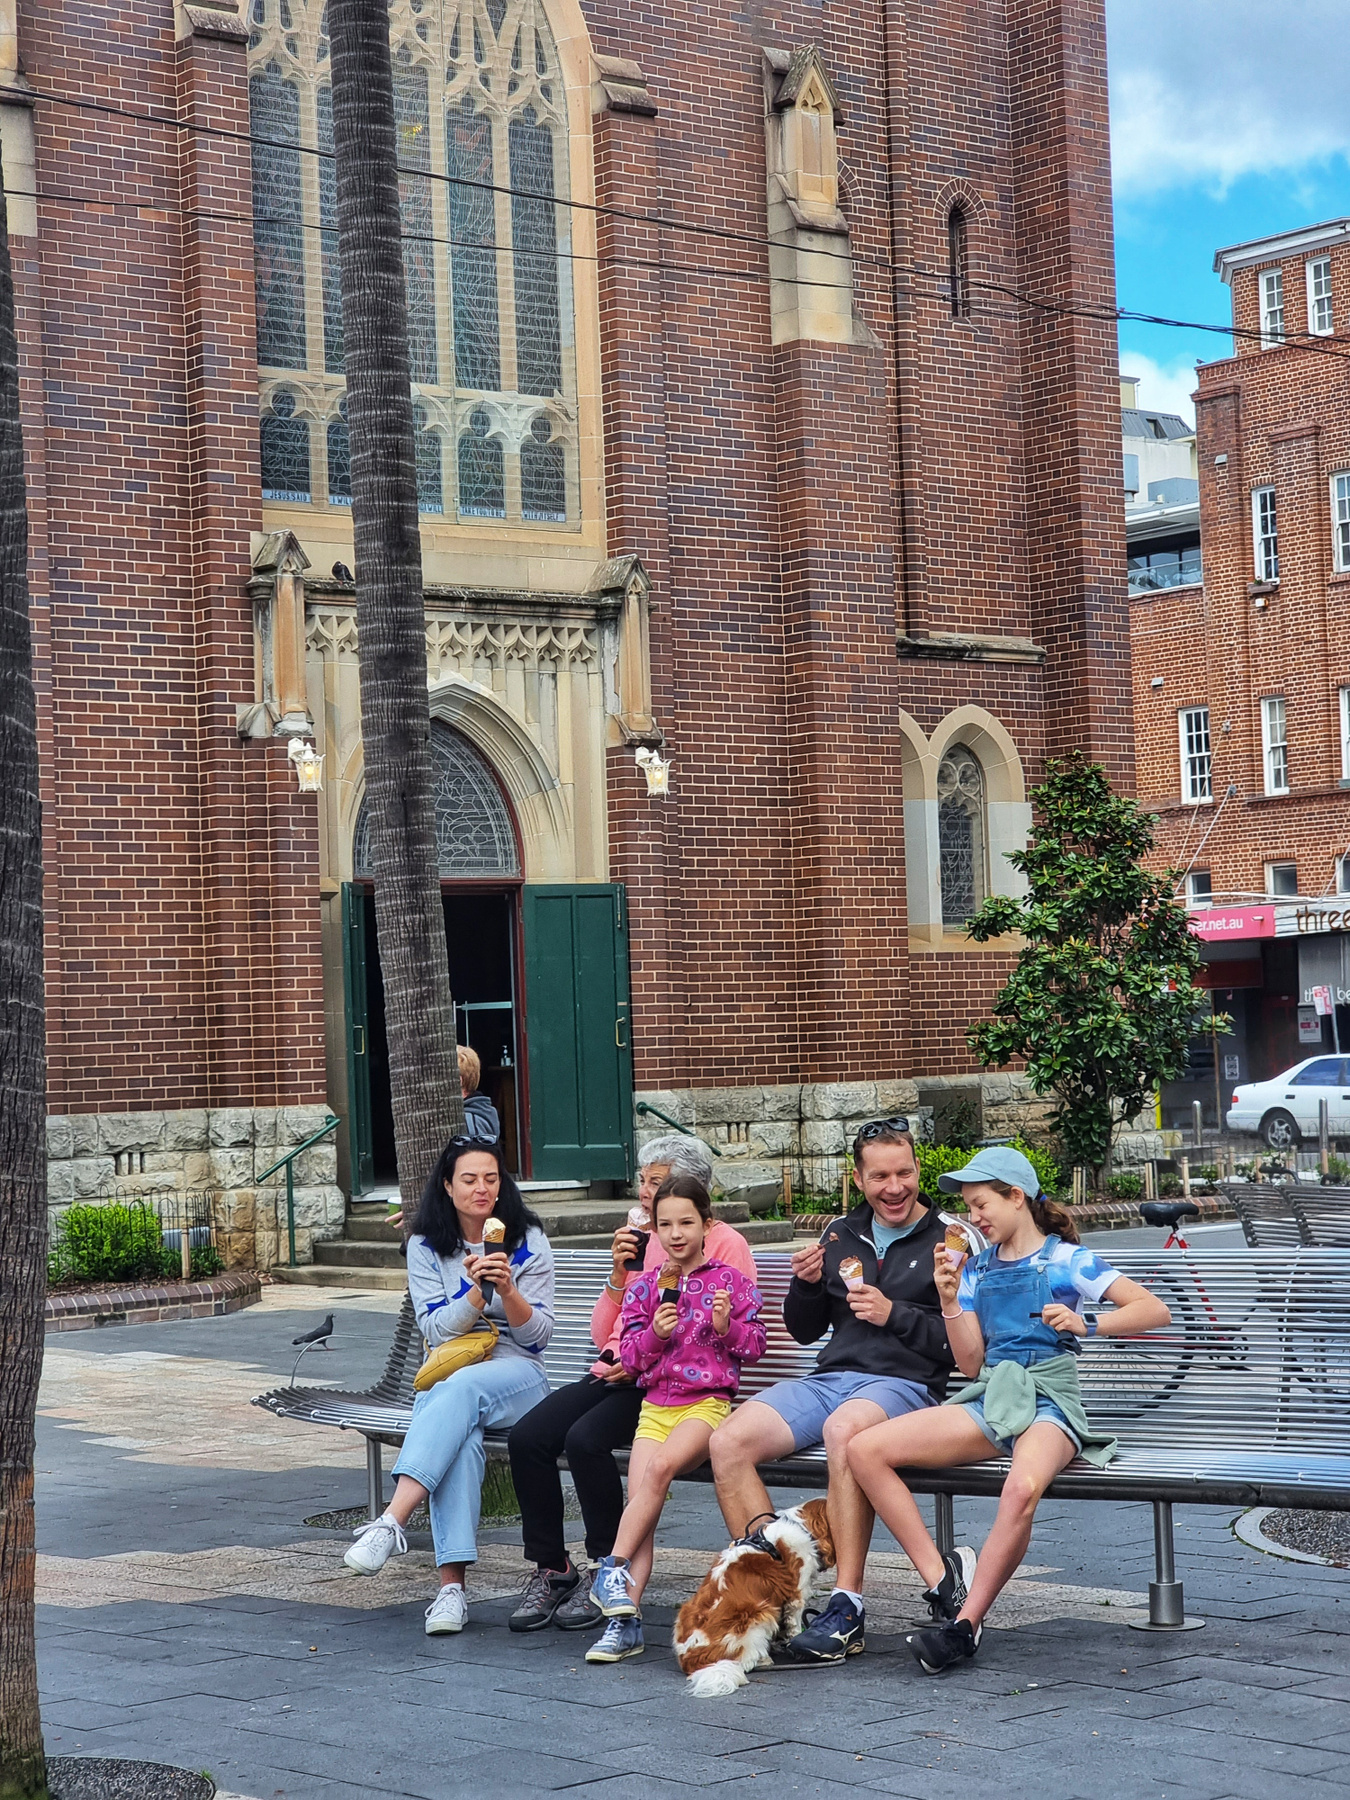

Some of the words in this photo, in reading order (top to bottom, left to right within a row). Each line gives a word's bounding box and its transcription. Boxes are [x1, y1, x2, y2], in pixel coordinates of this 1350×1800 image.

[270, 490, 290, 500] JESUS
[291, 492, 307, 501] SAID
[1295, 906, 1350, 933] three
